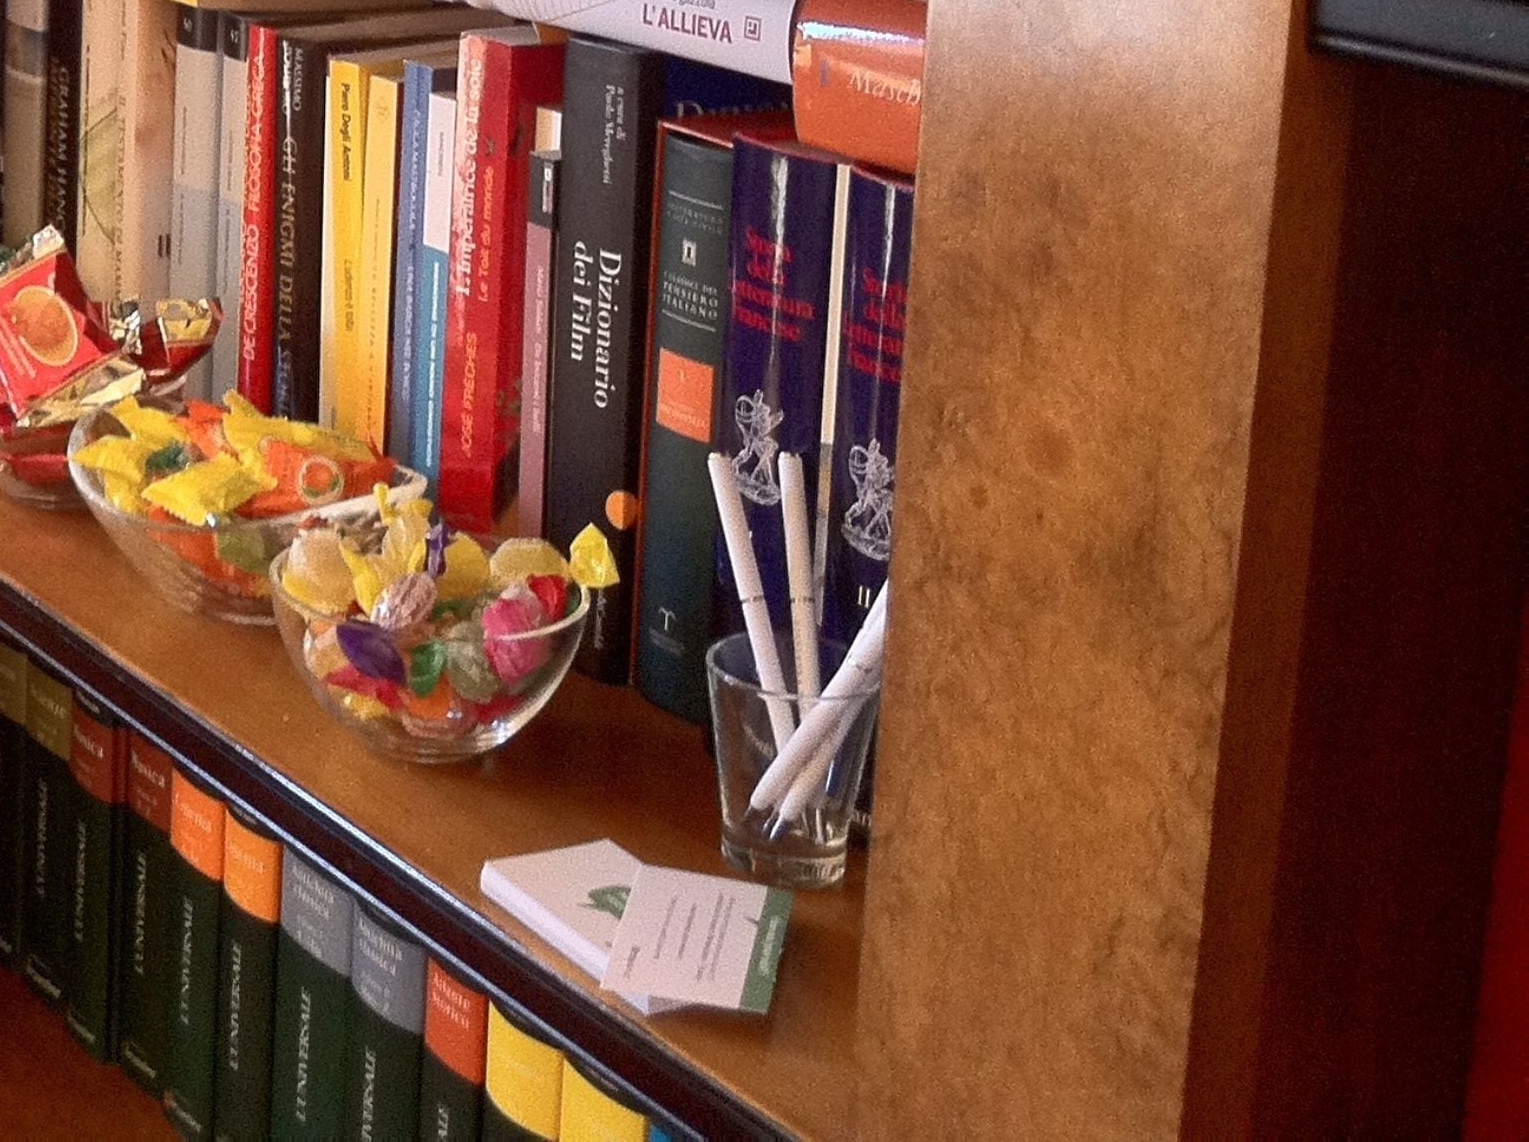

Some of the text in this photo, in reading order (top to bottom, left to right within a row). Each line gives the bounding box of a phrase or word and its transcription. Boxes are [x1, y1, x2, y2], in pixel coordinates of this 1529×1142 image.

[642, 3, 733, 44] L'ALLIEVA
[56, 67, 69, 232] GRAHAM HANC
[339, 83, 351, 181] Piero Degli Antoni
[243, 224, 260, 333] CRESCENZO
[278, 273, 293, 340] DELLA
[571, 240, 594, 361] dei Film
[241, 337, 254, 359] DE
[594, 247, 622, 409] Dizionario
[361, 1045, 377, 1142] IVERSALE
